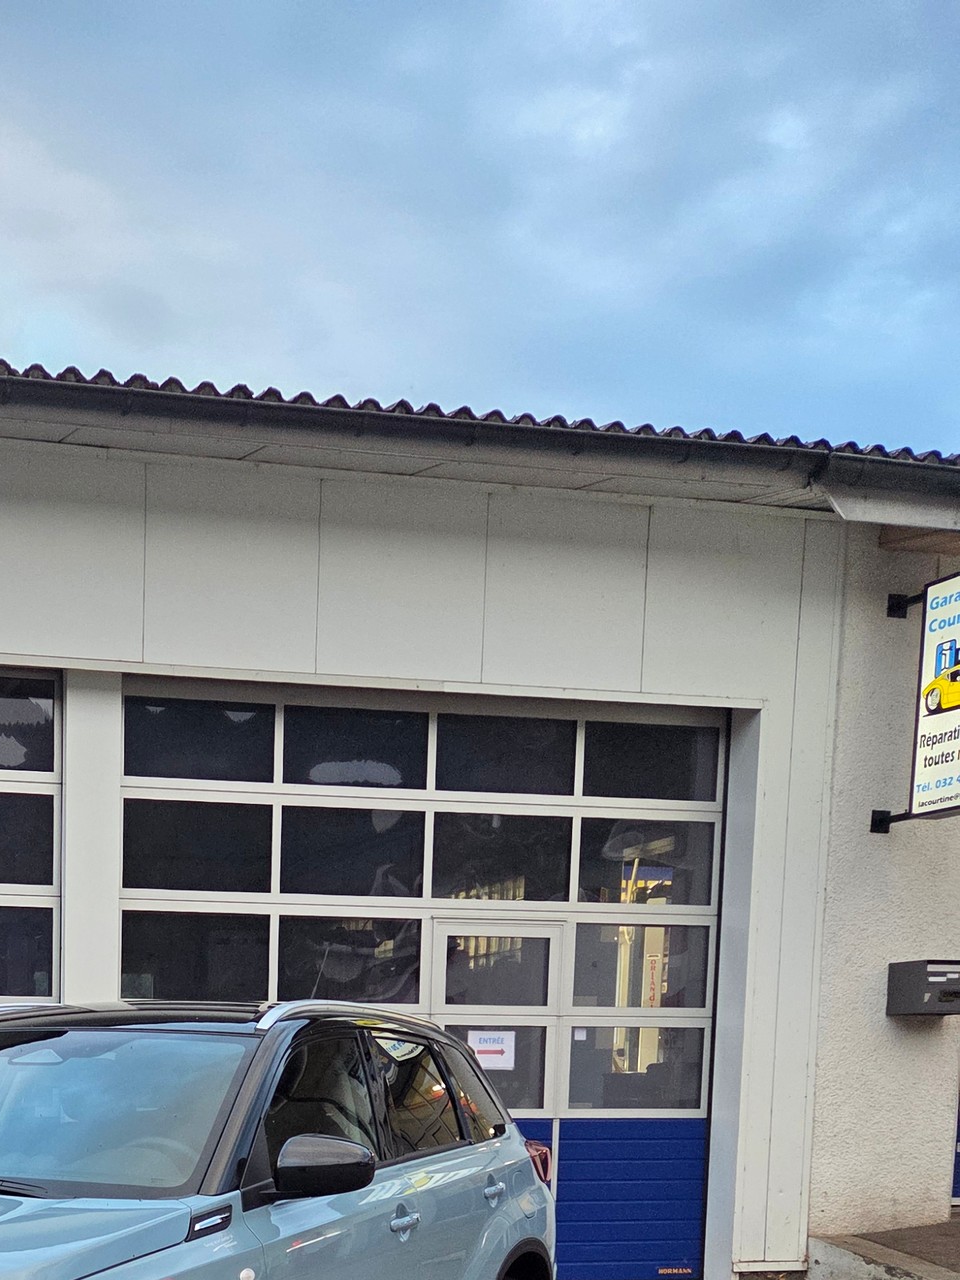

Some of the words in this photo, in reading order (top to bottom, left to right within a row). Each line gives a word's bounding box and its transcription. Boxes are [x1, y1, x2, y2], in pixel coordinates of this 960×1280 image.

[923, 750, 955, 768] toutes
[935, 776, 954, 789] 032
[478, 1036, 505, 1045] ENTRÉE
